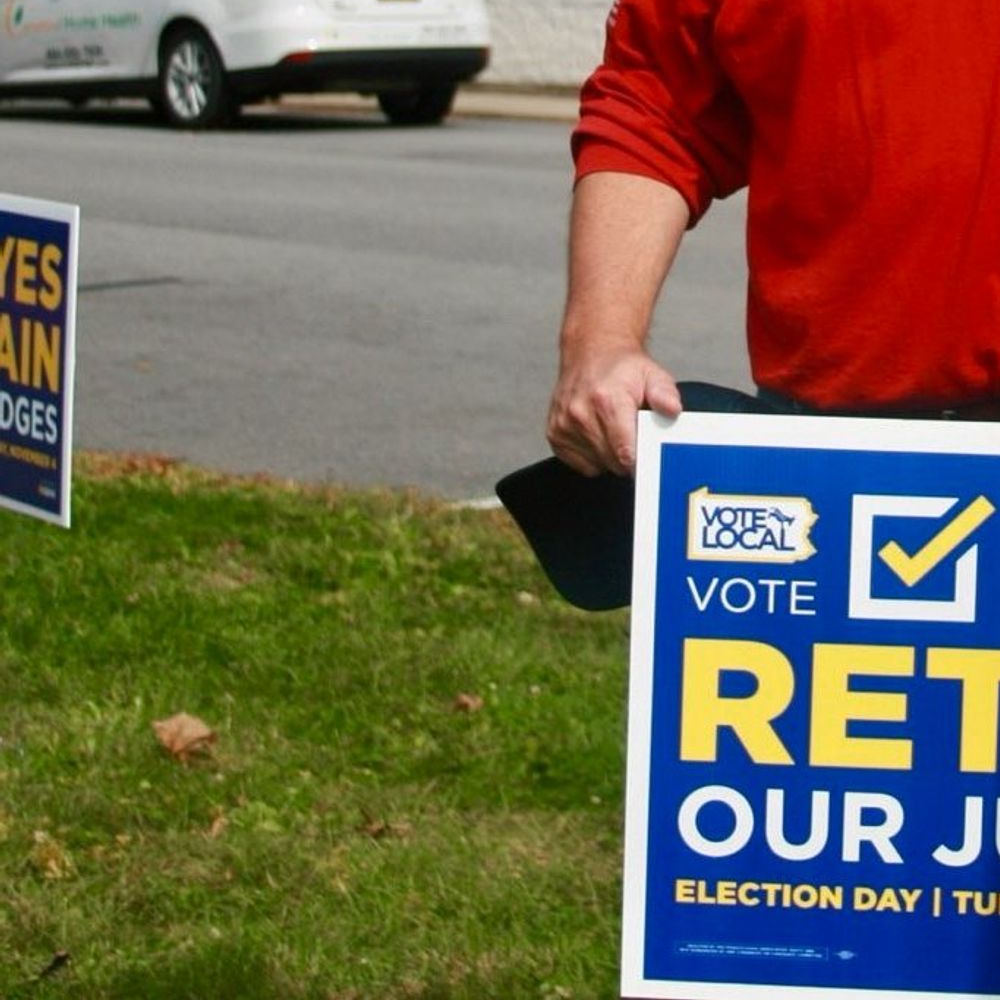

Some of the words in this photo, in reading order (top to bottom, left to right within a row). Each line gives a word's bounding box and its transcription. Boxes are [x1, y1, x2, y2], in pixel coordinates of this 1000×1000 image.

[701, 506, 768, 528] VOTE
[702, 526, 796, 552] LOCAL
[686, 576, 818, 616] VOTE
[677, 785, 904, 865] OUR
[675, 879, 843, 910] ELECTION
[853, 887, 922, 913] DAY
